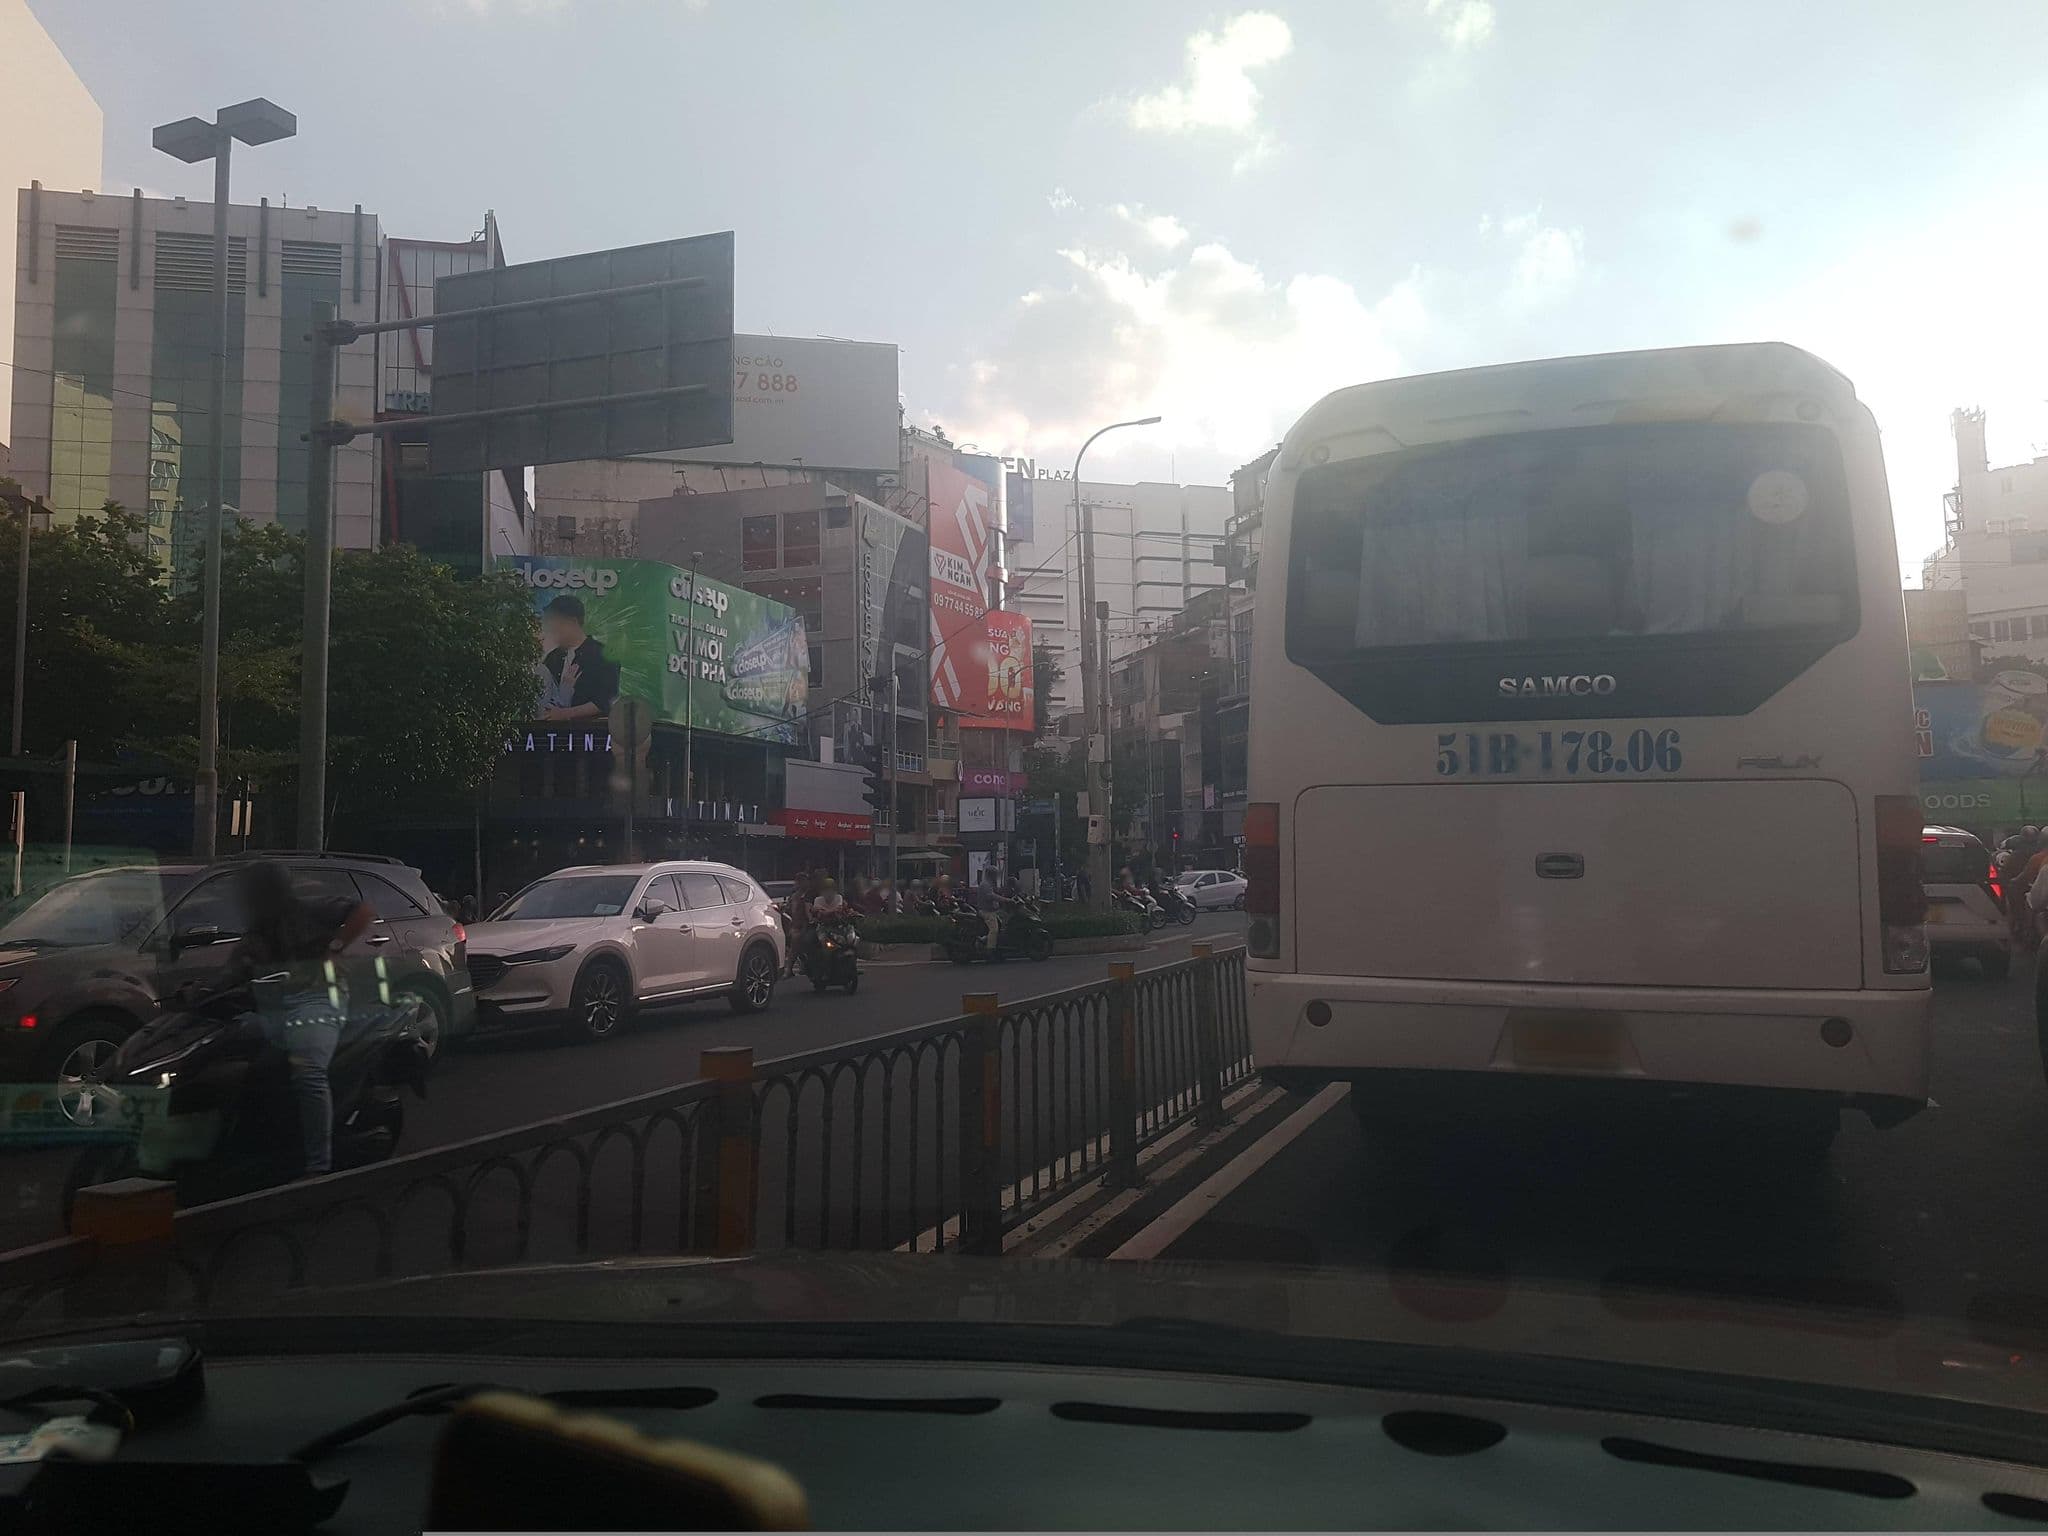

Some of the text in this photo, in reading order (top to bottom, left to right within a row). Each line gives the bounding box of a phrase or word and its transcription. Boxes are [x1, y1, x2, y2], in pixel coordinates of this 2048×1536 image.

[758, 373, 798, 393] 888
[1499, 674, 1617, 697] SAMCO
[666, 798, 758, 821] KTINAT
